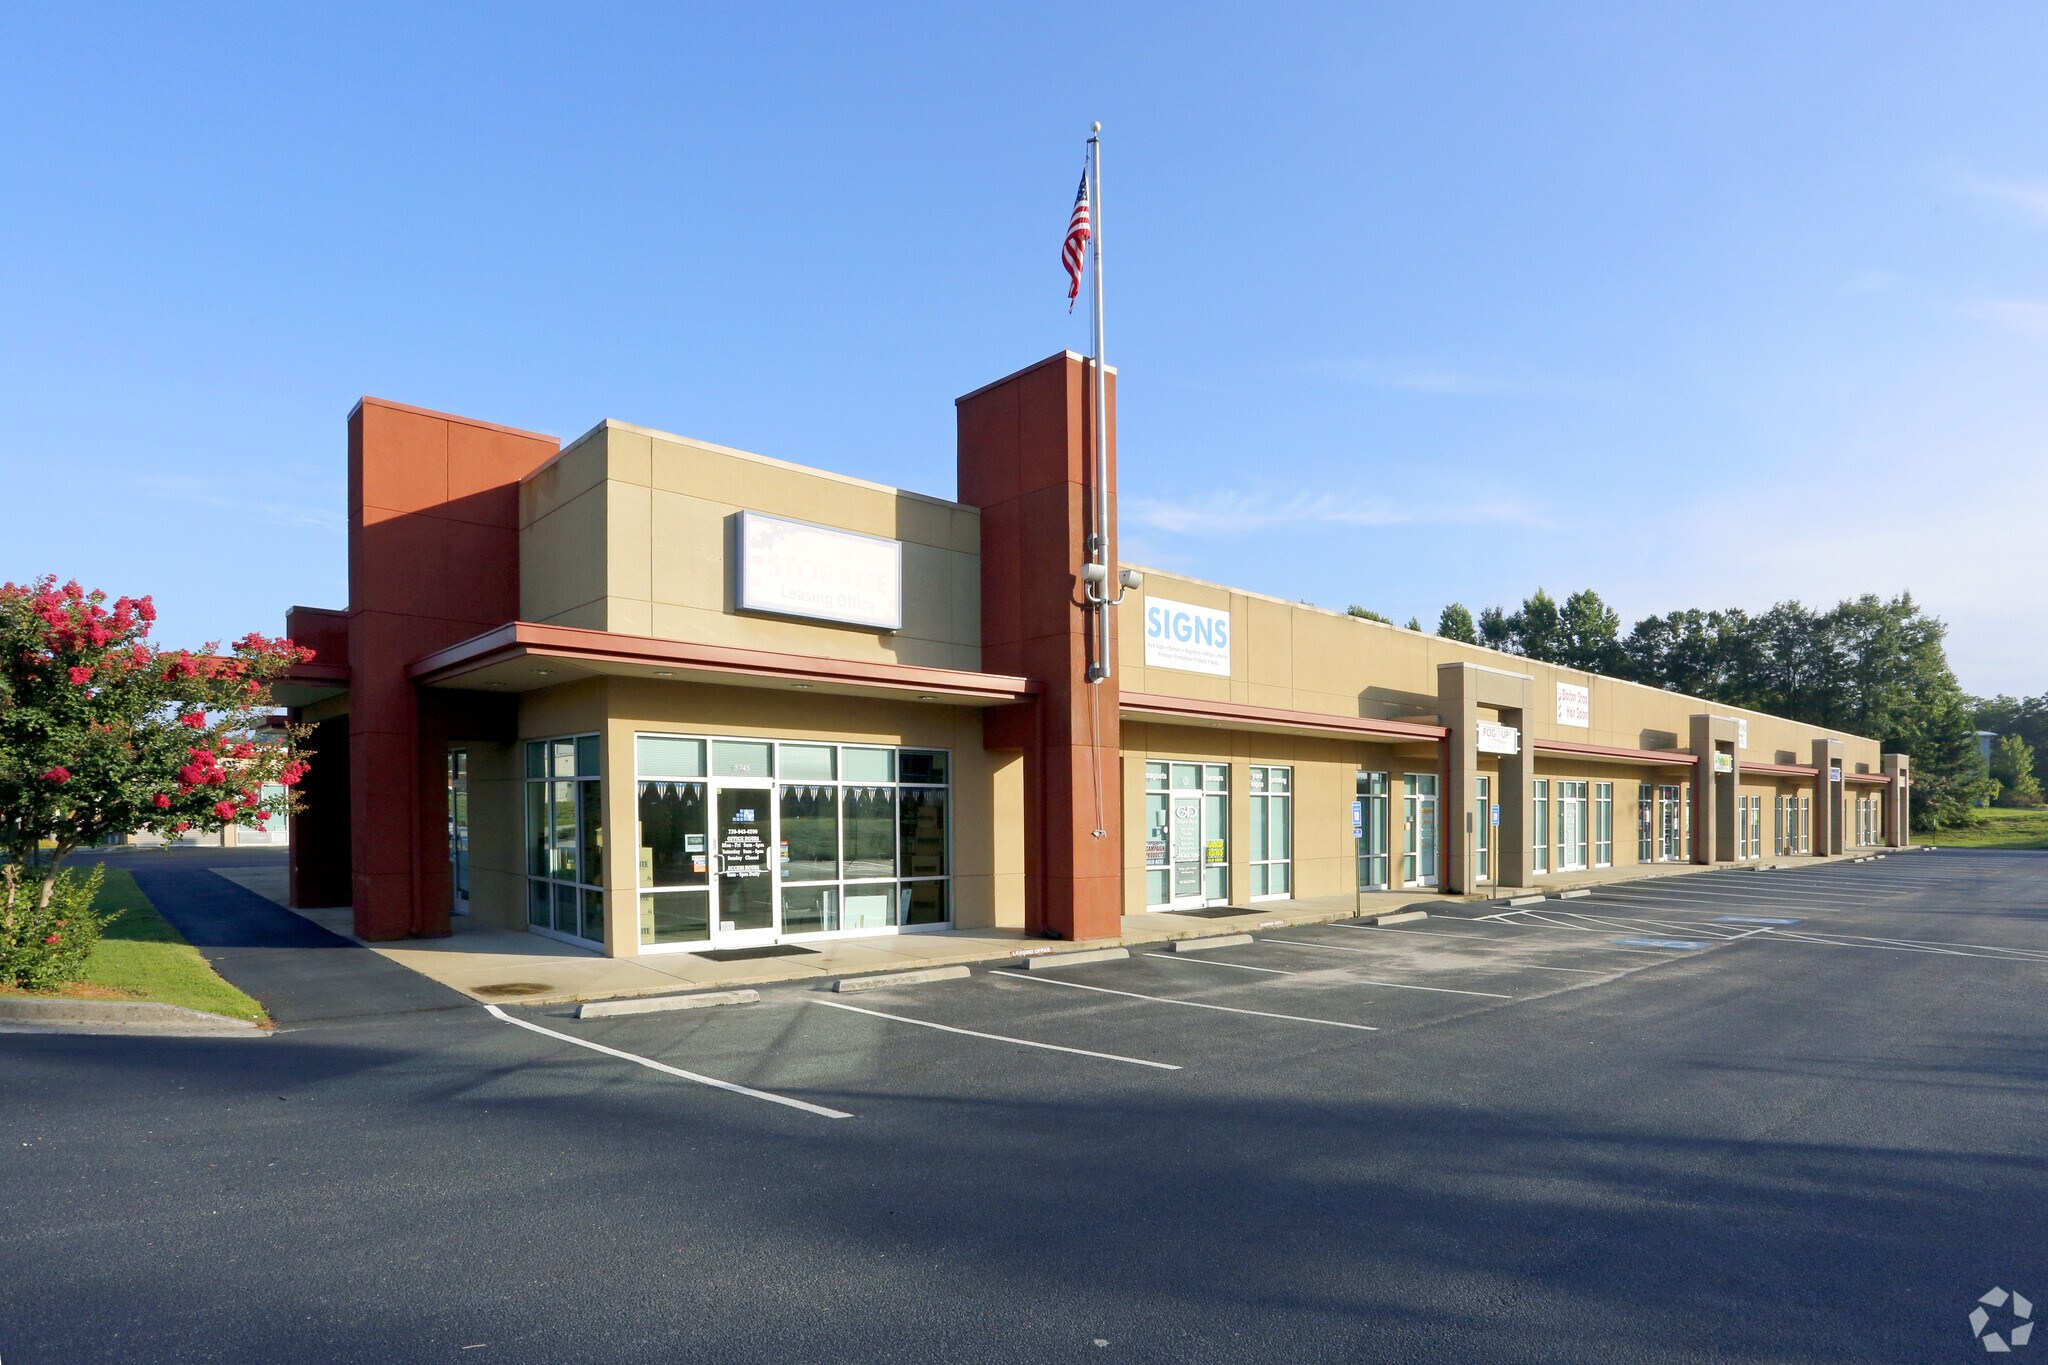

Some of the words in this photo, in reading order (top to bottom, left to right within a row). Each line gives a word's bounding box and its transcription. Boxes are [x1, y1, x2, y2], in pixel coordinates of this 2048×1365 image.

[767, 553, 887, 594] STORAGE
[781, 584, 833, 608] Leasing
[836, 593, 876, 612] Office
[1147, 606, 1227, 649] SIGNS
[1562, 689, 1576, 702] Barber
[1578, 692, 1588, 706] Shop
[1566, 706, 1576, 718] Hair
[1576, 708, 1588, 720] Salon
